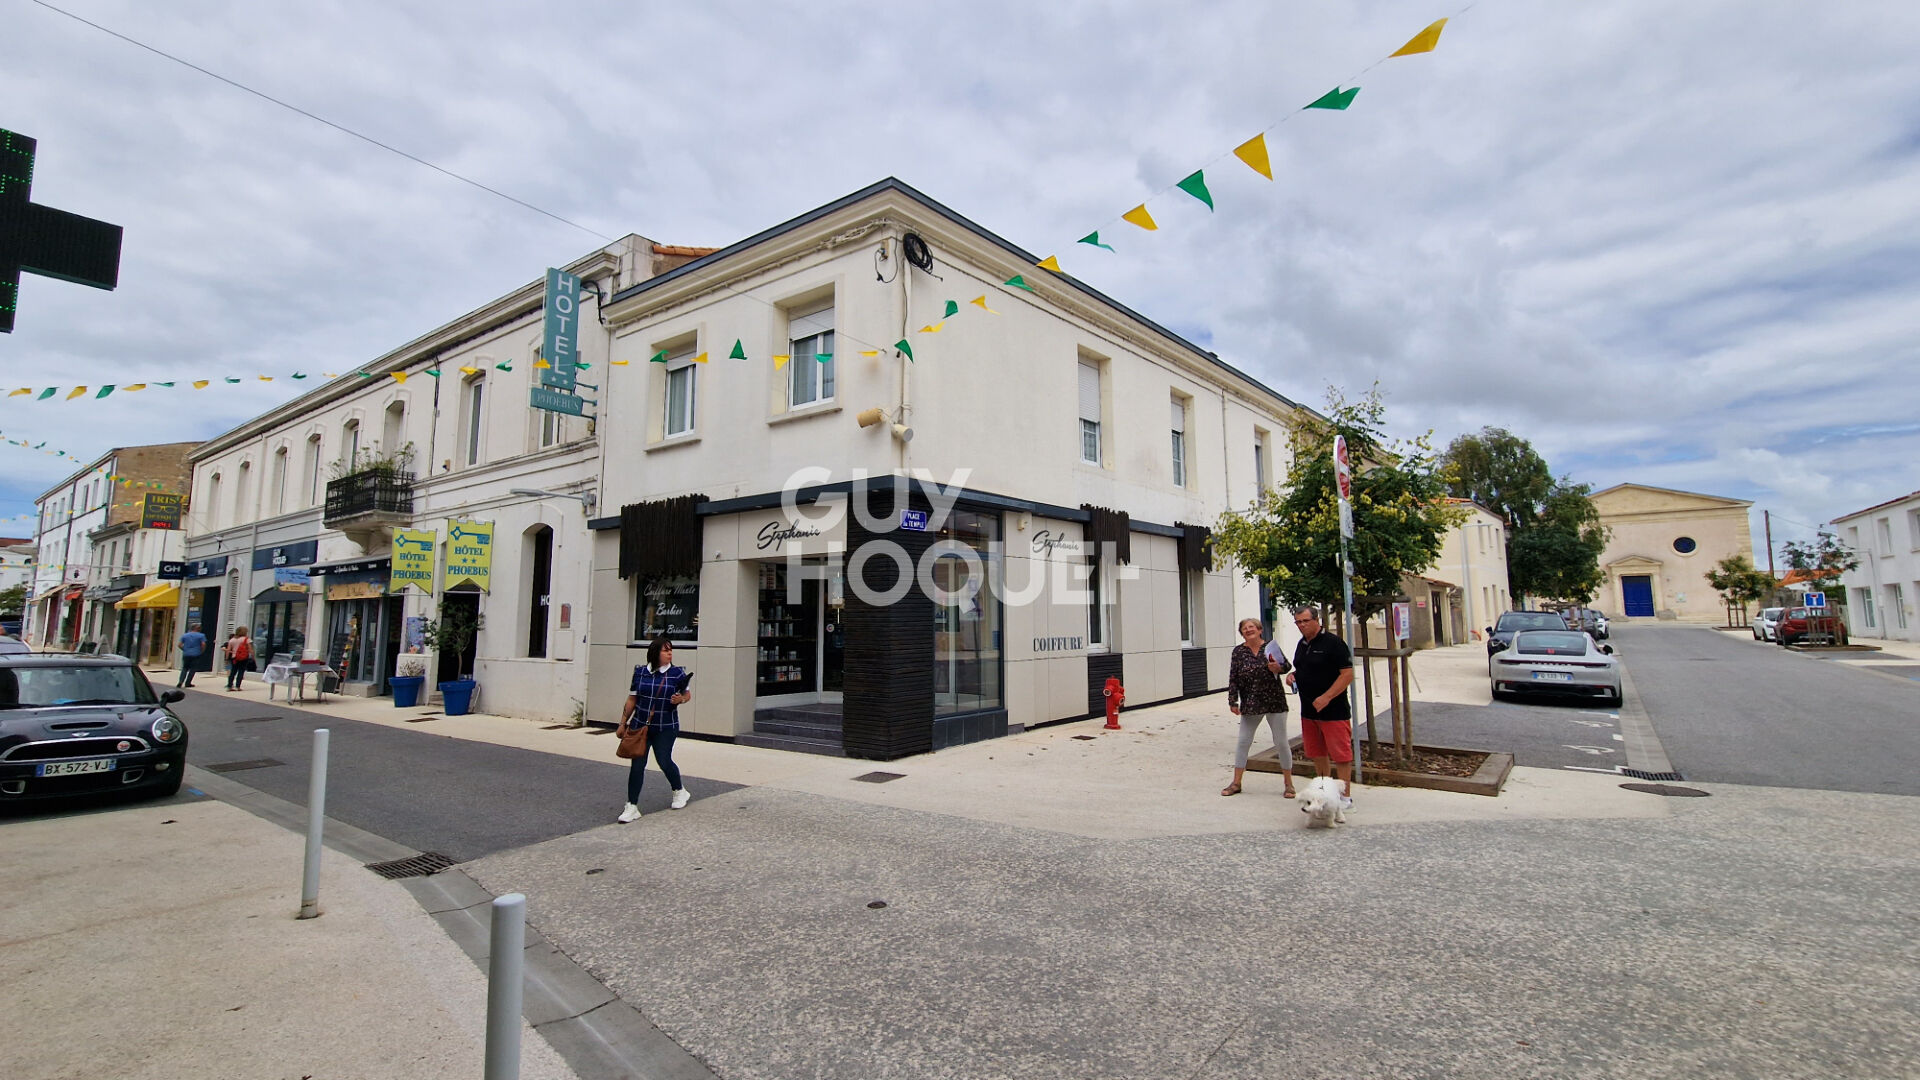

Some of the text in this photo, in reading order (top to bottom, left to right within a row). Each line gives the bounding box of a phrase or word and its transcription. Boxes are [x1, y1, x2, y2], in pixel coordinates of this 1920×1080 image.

[554, 273, 573, 376] HOTEL
[536, 392, 579, 412] PHOEBUS
[152, 495, 177, 504] IRIS
[454, 545, 485, 556] HÔTEL
[399, 552, 428, 561] HÔTEL
[163, 565, 180, 573] GH
[392, 569, 431, 580] PHOEBUS
[447, 565, 489, 576] PHOEBUS
[656, 602, 682, 616] Barbier
[1033, 637, 1083, 652] COIFFURE
[45, 761, 109, 775] BX-572-VJ
